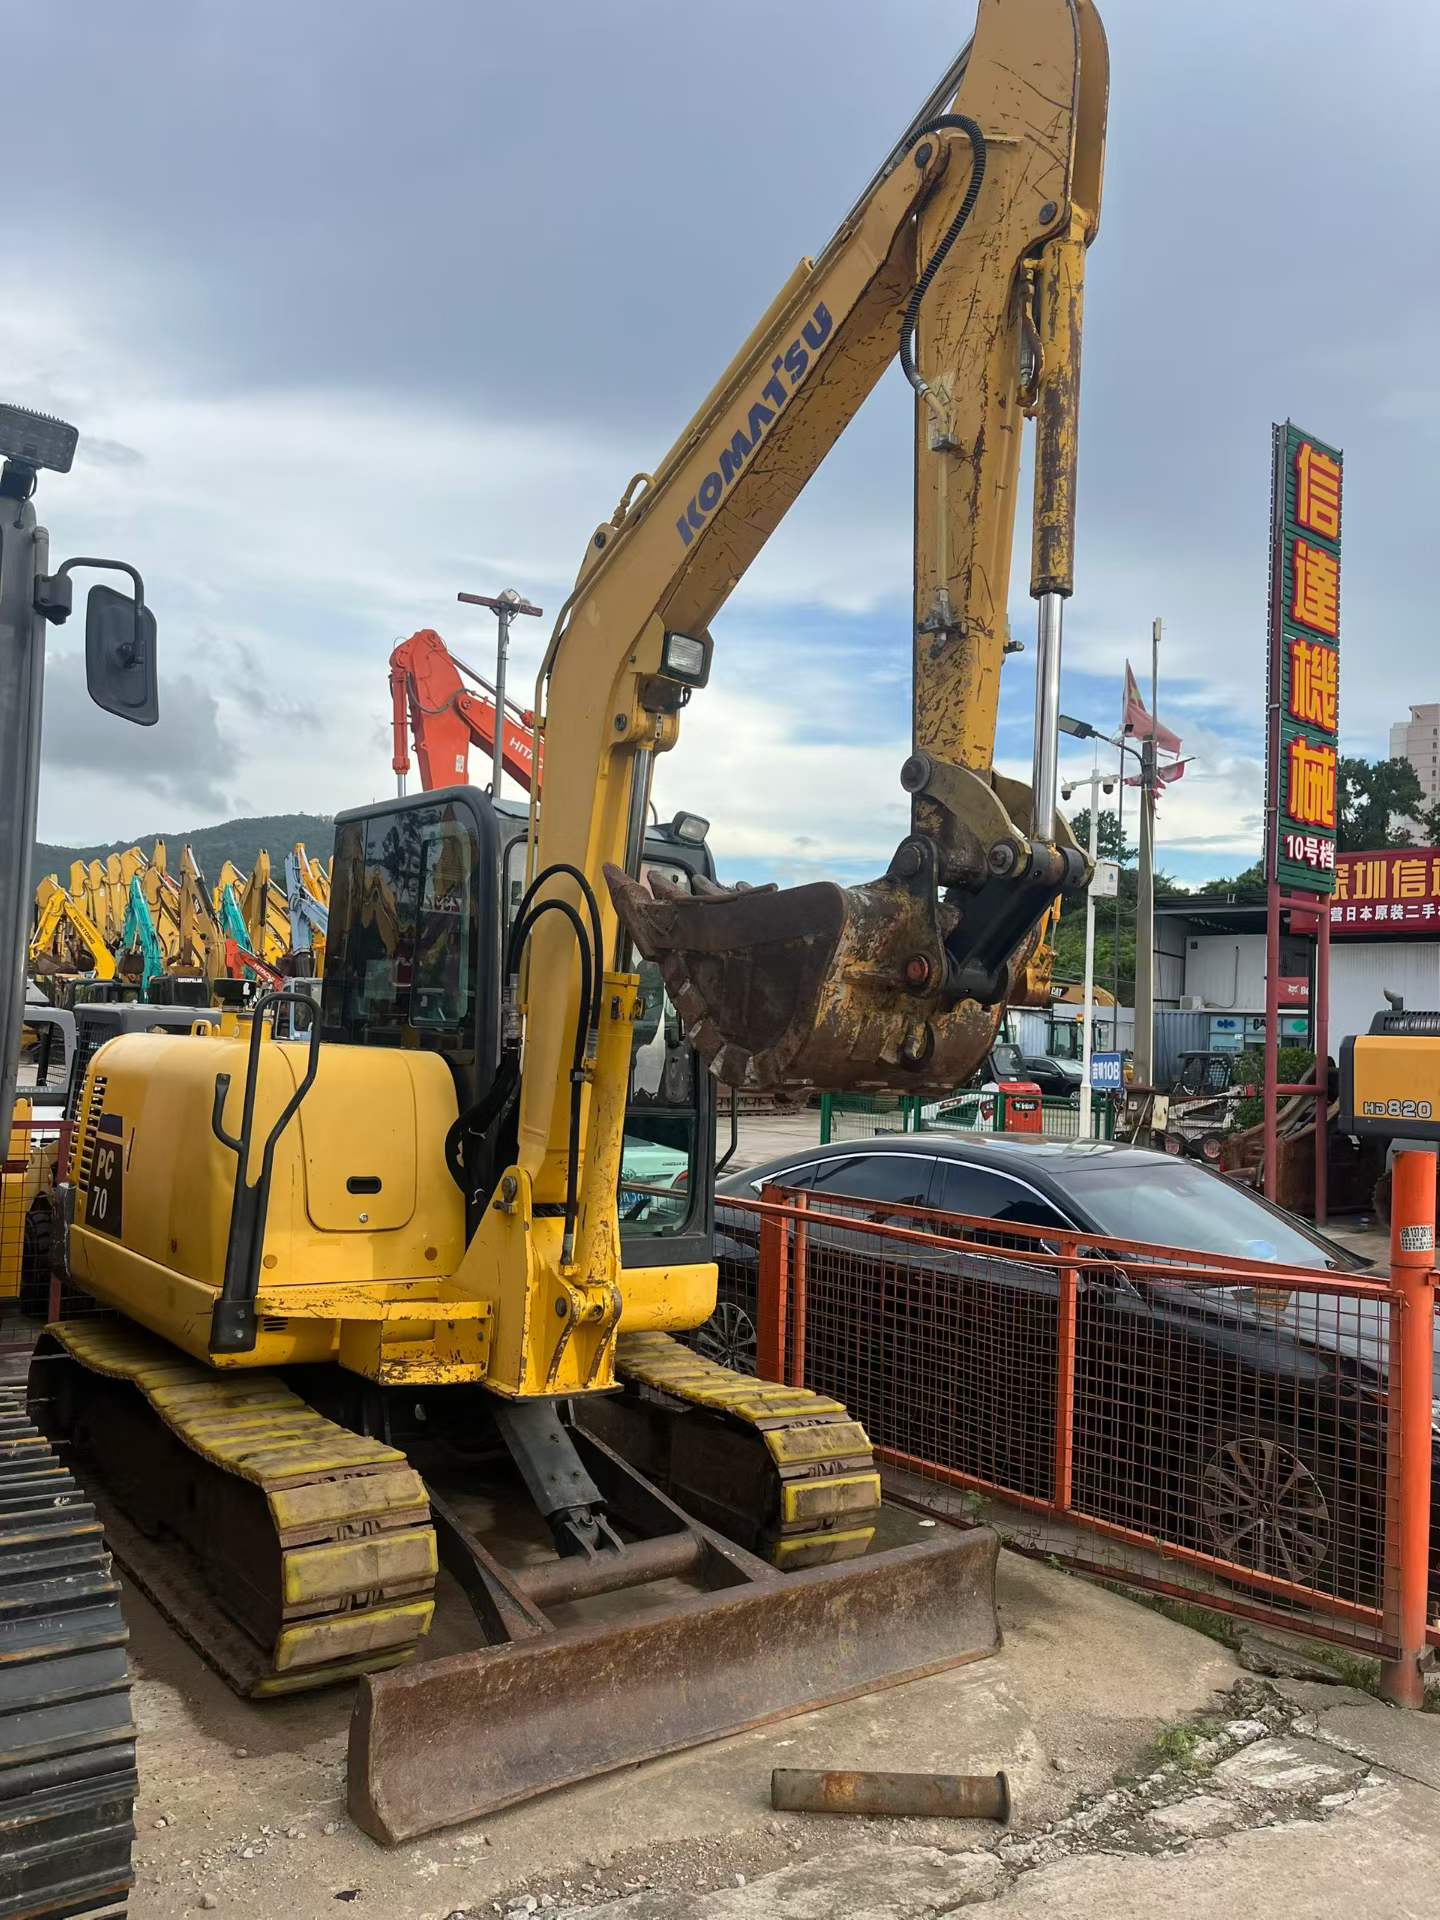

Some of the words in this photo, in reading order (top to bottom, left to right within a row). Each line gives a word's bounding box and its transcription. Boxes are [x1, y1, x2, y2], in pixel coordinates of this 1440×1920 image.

[676, 301, 834, 547] KOMATSU
[1286, 834, 1335, 869] 10号档
[1363, 1098, 1433, 1119] HD820
[96, 1147, 115, 1181] PC
[91, 1185, 108, 1220] 70
